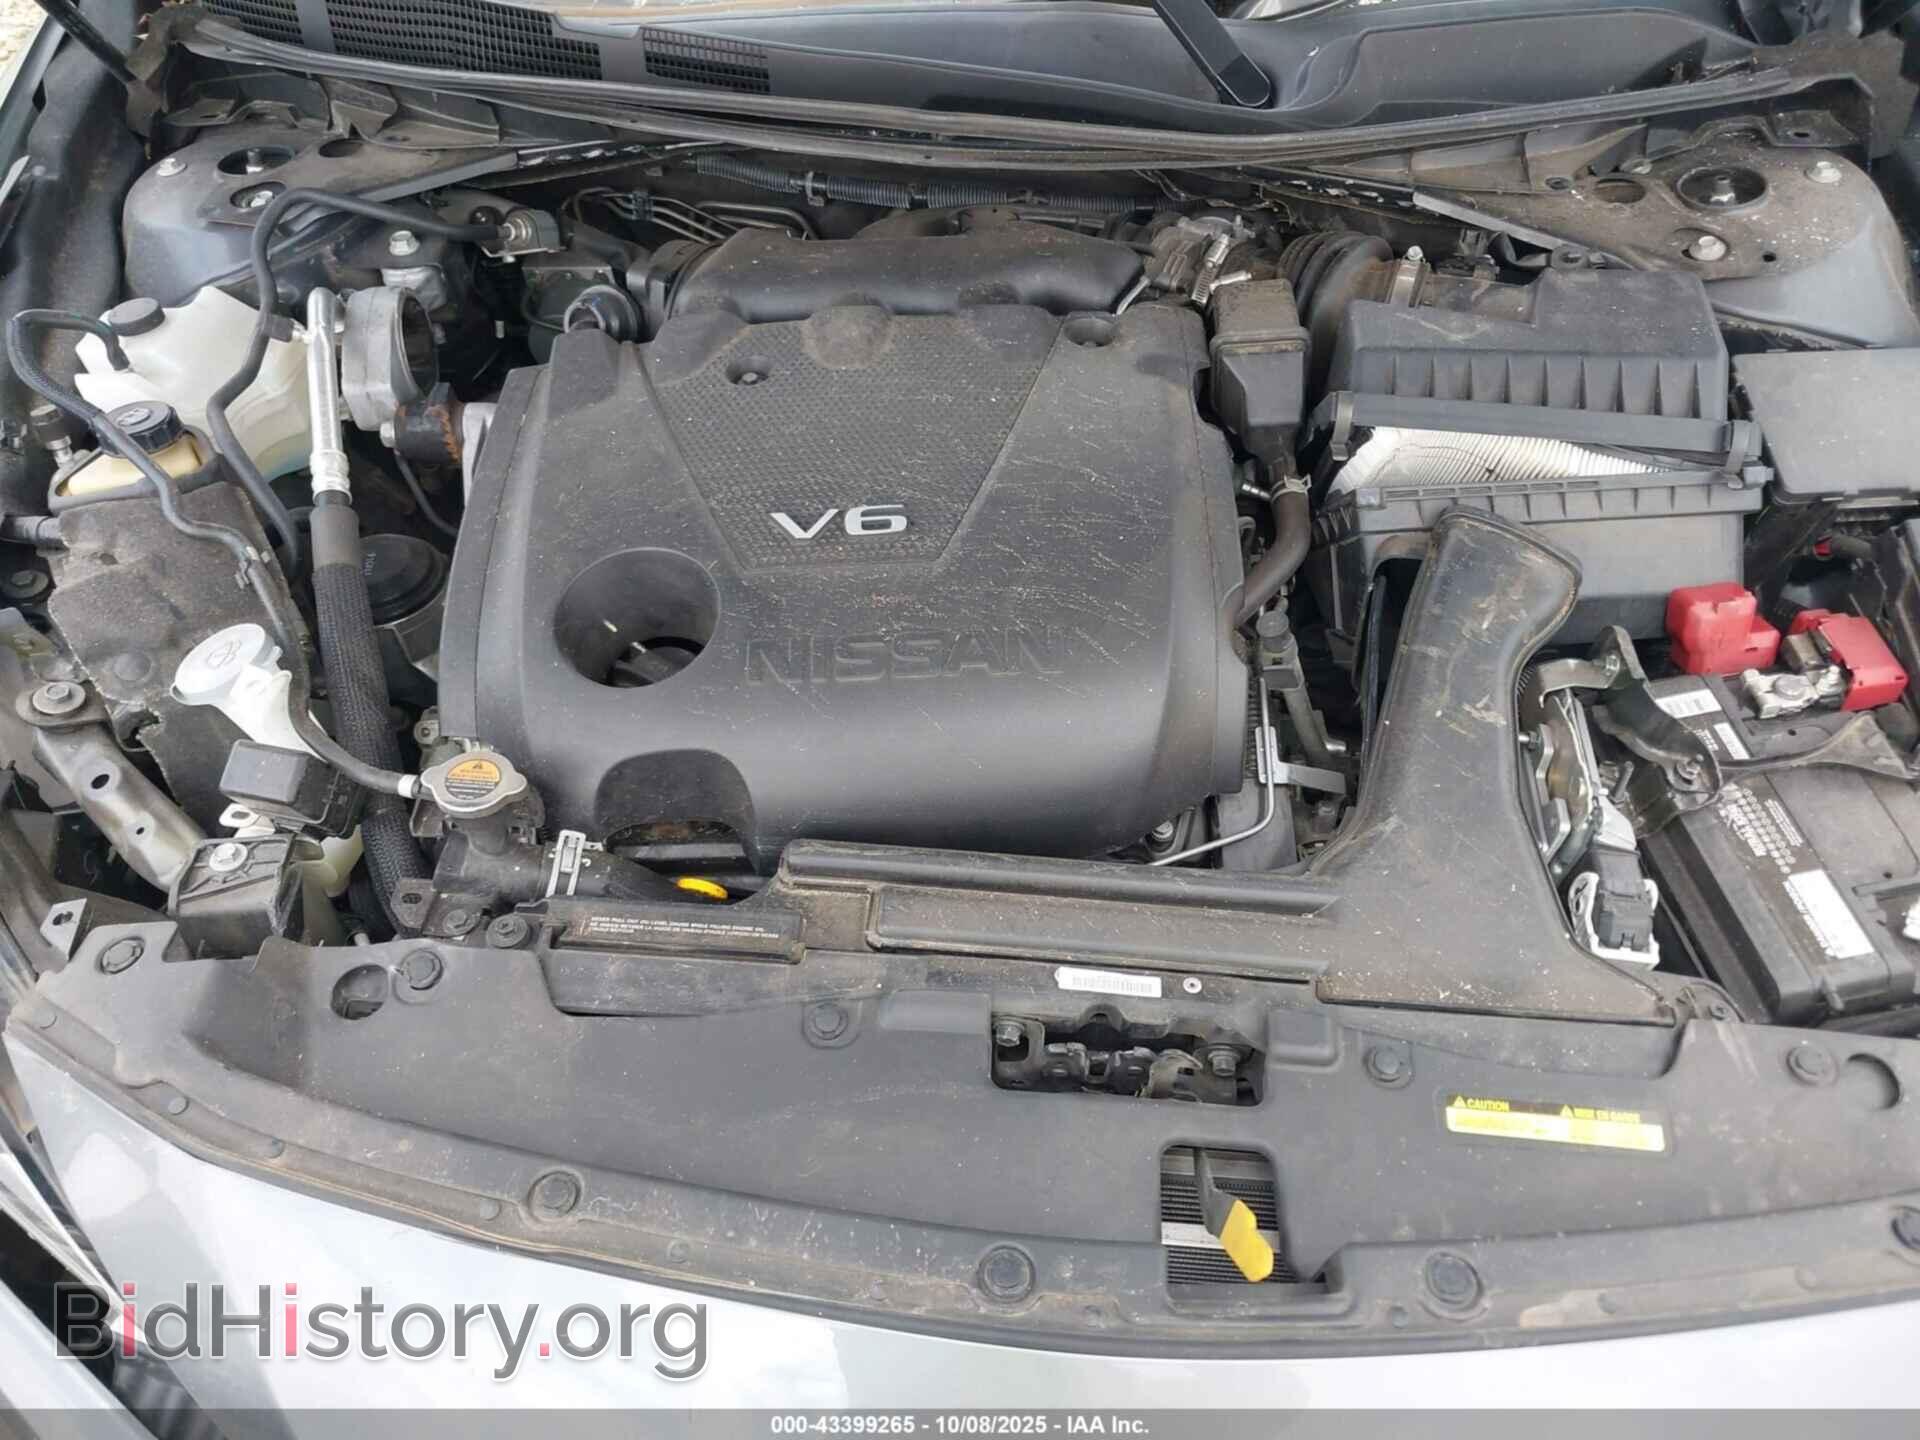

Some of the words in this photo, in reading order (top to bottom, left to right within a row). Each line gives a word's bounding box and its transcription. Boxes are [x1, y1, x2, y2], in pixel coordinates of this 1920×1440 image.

[770, 504, 908, 540] V6
[745, 629, 1066, 685] NISSAN
[1466, 1098, 1510, 1112] CAUTION
